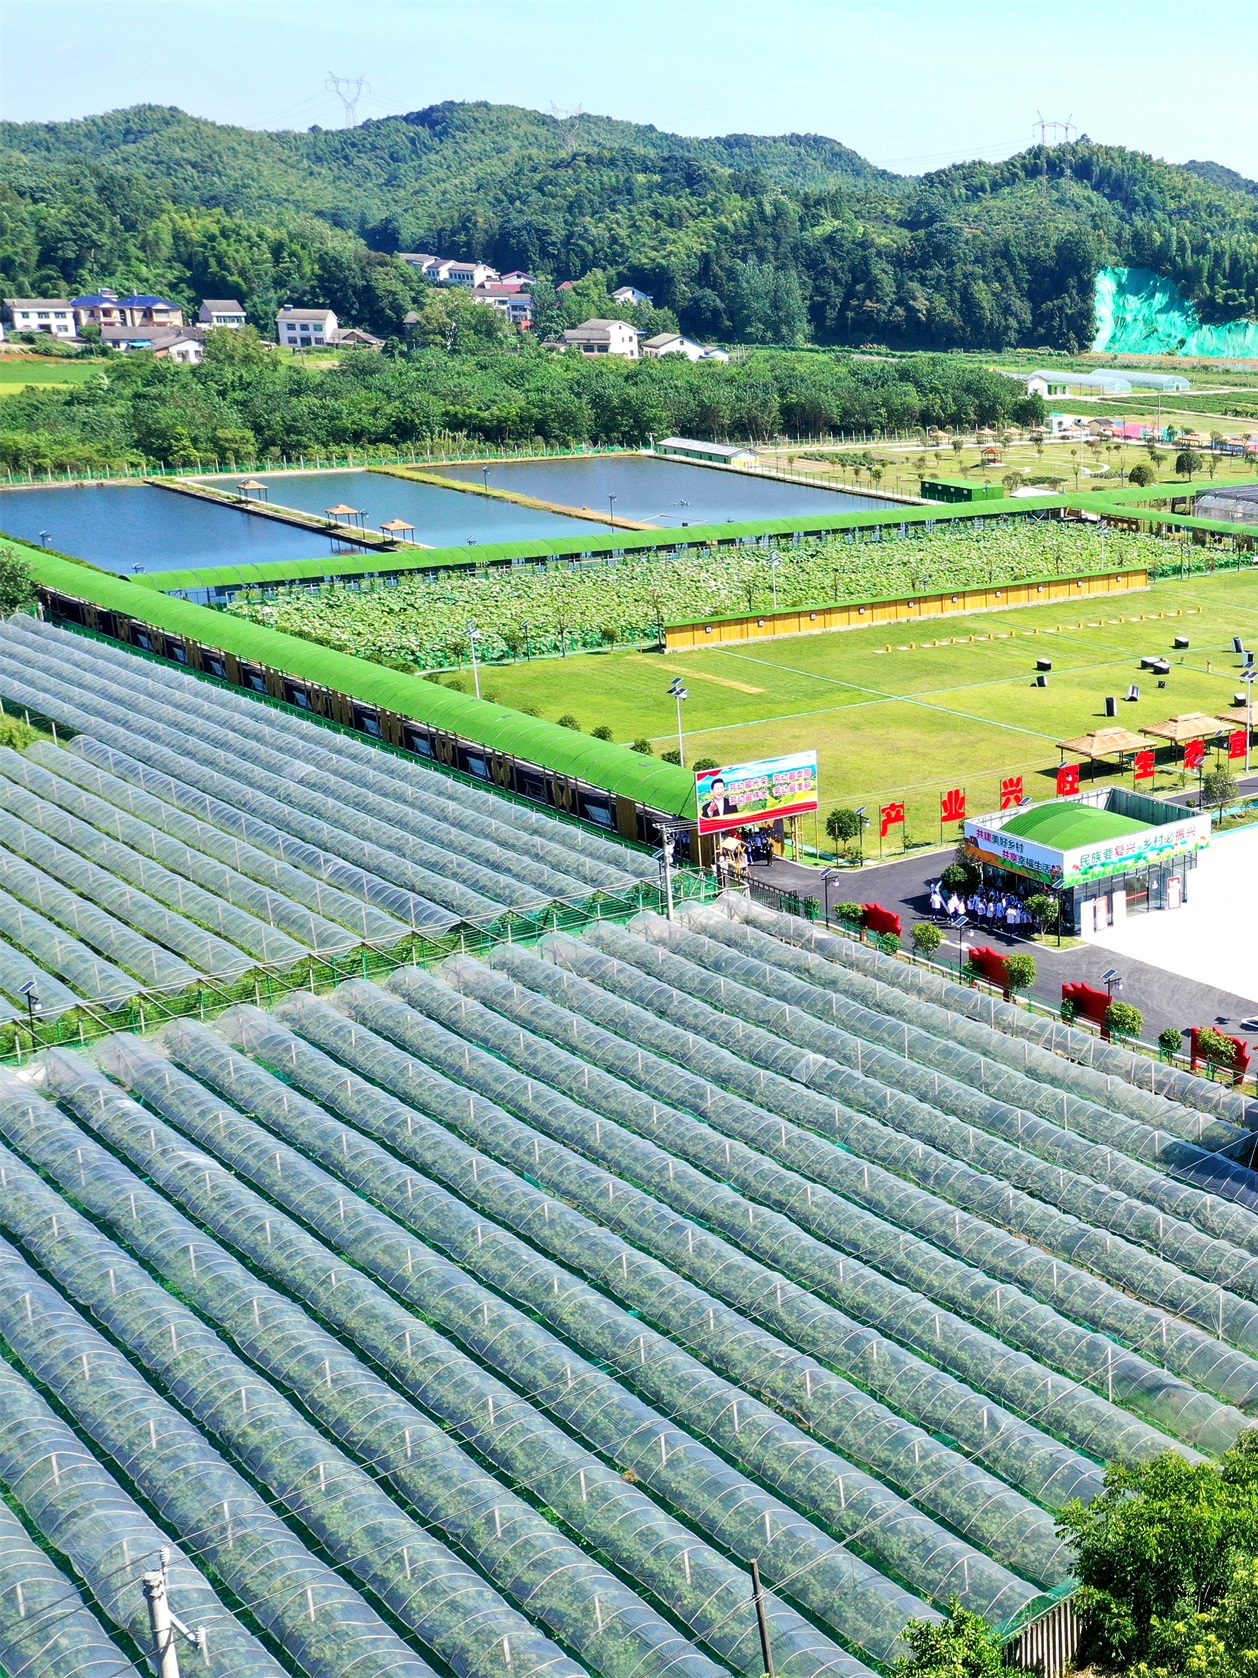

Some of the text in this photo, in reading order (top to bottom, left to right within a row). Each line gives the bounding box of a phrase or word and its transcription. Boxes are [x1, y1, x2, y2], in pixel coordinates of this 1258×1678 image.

[976, 828, 1024, 854] 共建美好乡村
[1080, 826, 1196, 867] 民族要复兴 乡村必振兴
[1002, 849, 1051, 873] 共享幸福生活
